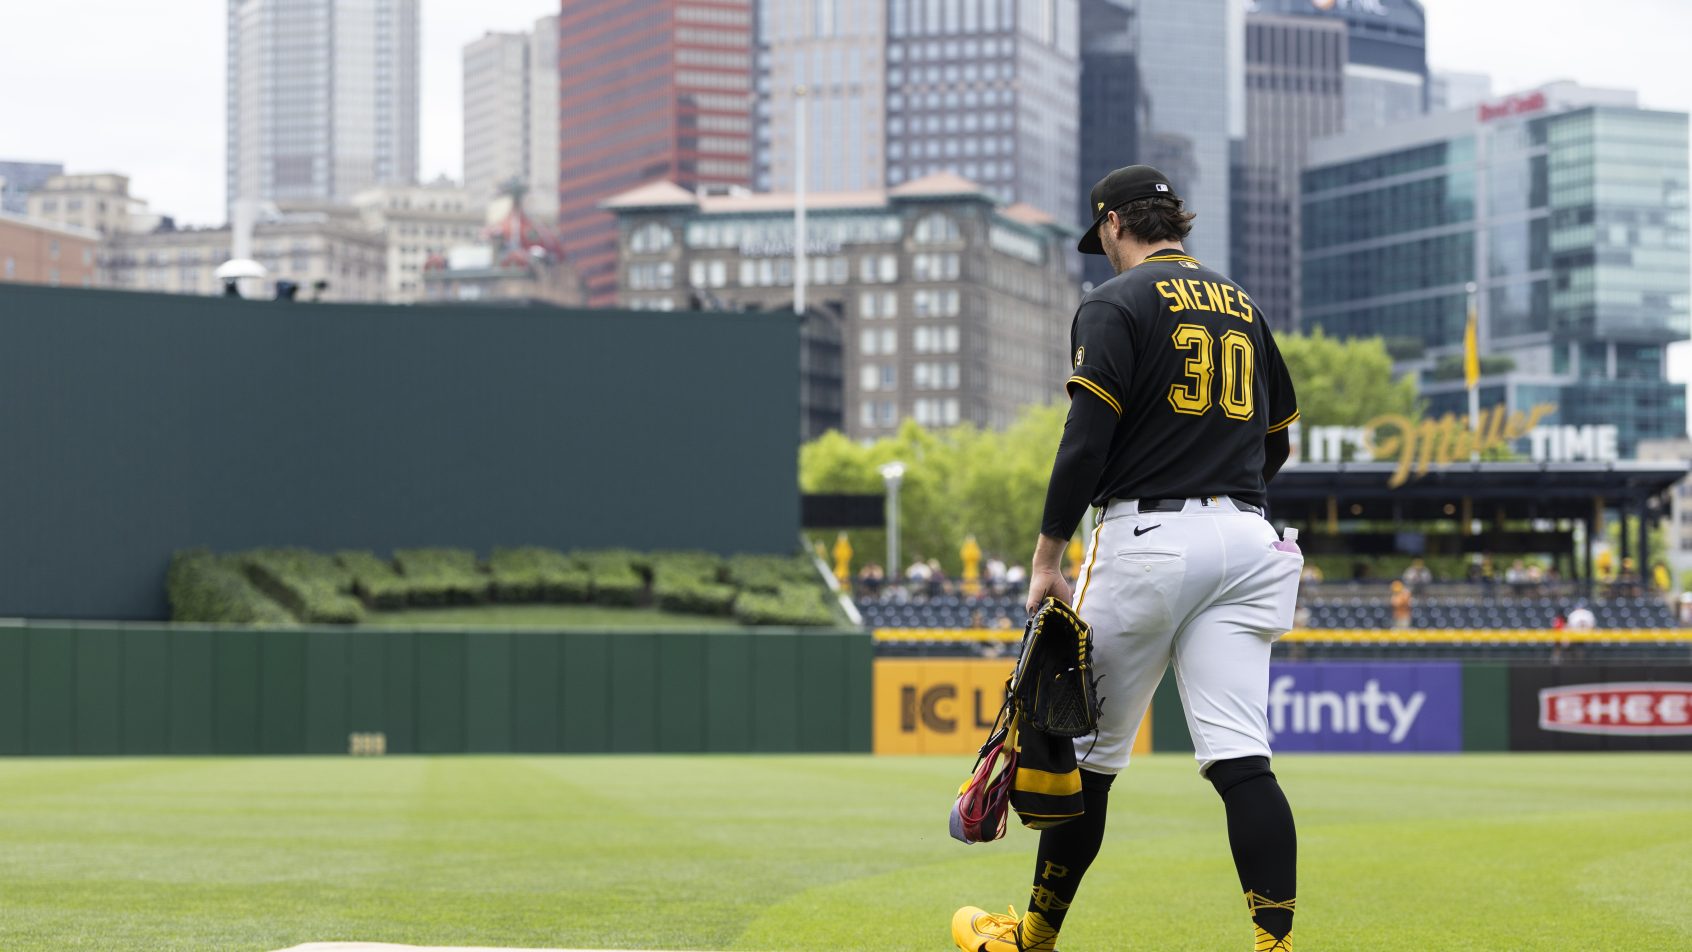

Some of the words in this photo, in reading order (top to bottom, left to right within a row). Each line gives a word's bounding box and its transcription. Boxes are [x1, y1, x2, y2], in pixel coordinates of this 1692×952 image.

[1155, 278, 1253, 323] SKENES
[1167, 323, 1254, 421] 30
[1364, 403, 1558, 489] Miller
[1530, 424, 1618, 462] TIME
[901, 683, 958, 734] IC
[1267, 675, 1426, 743] finity
[1556, 694, 1692, 724] SHEE
